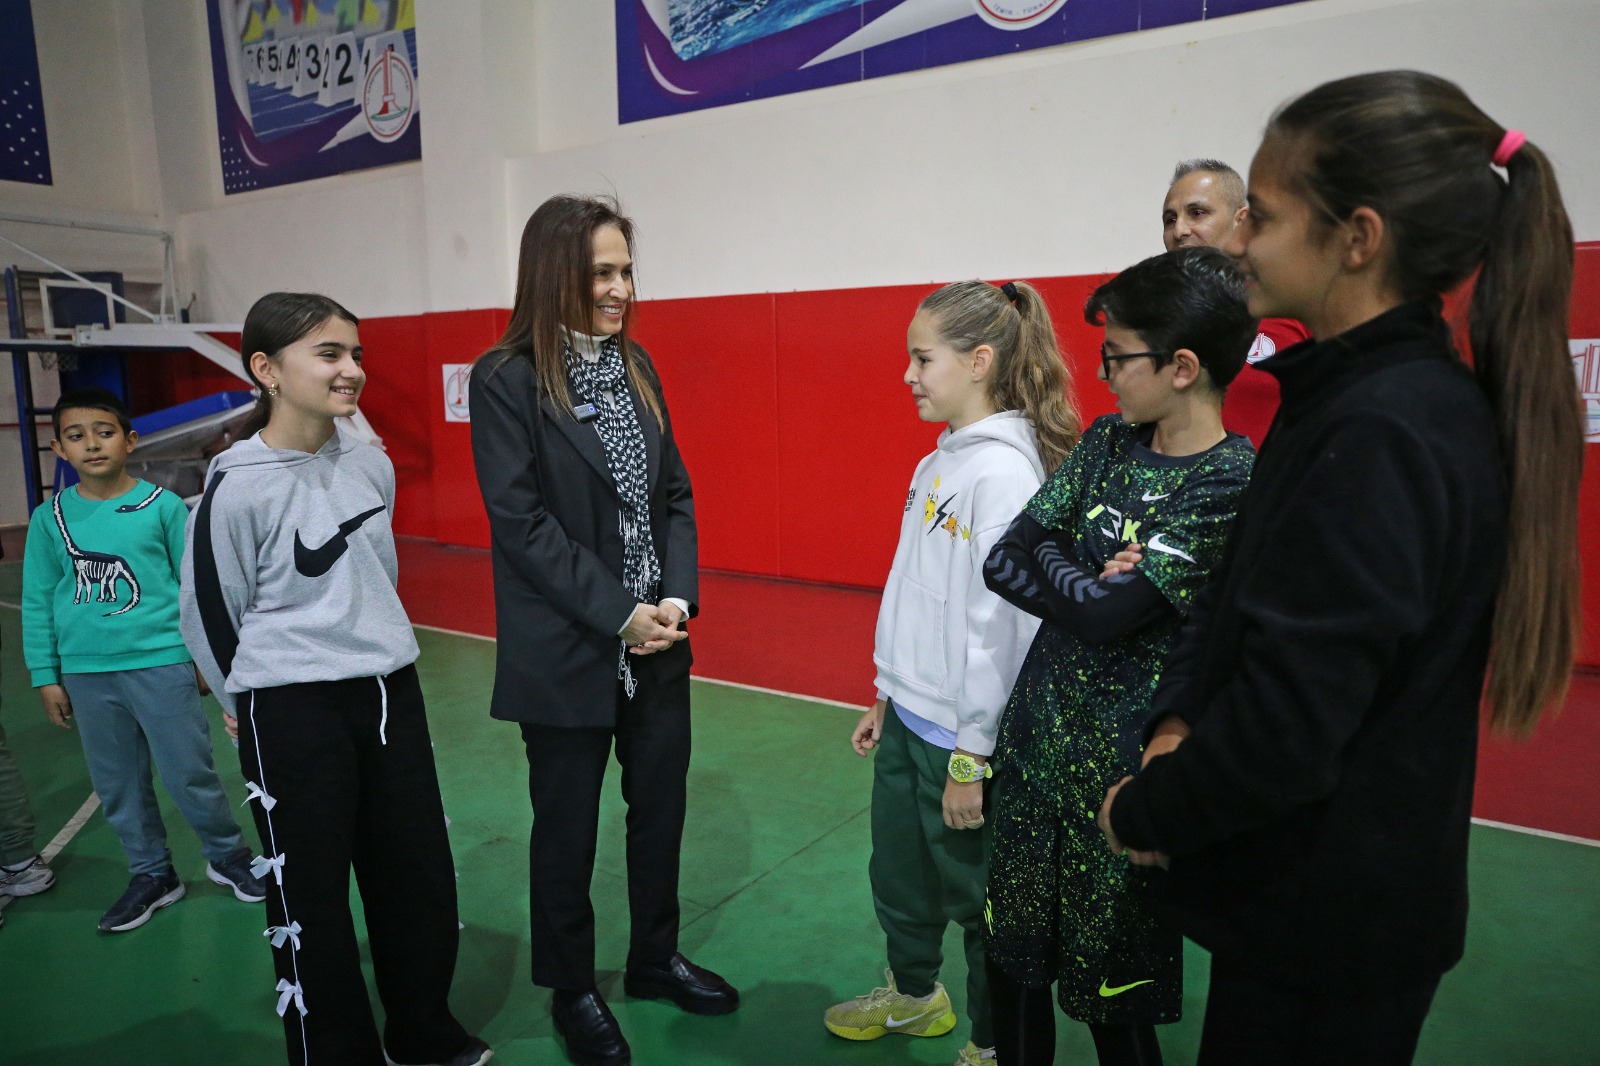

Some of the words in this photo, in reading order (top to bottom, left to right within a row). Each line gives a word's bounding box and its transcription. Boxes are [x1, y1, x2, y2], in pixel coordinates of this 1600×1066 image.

[268, 45, 279, 72] 5
[286, 44, 296, 70] 4
[305, 43, 321, 79] 3
[335, 43, 354, 86] 2
